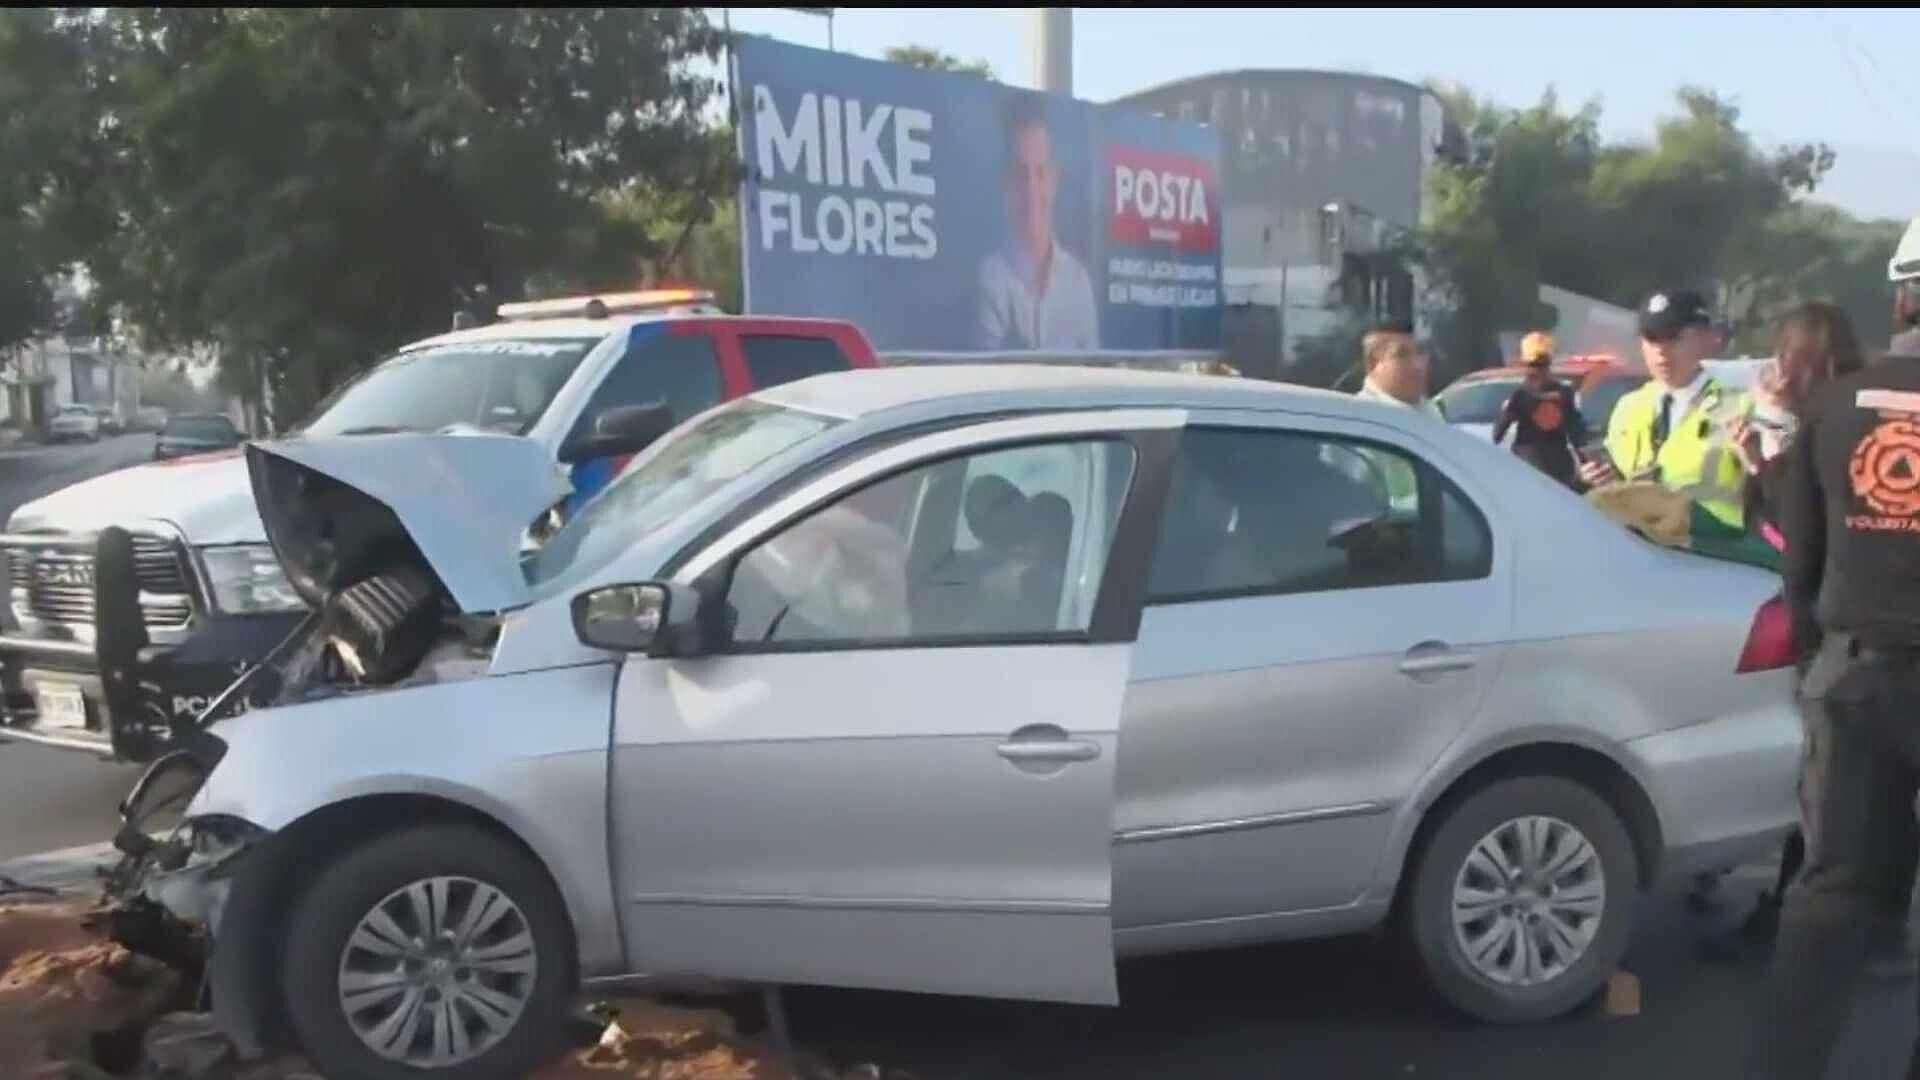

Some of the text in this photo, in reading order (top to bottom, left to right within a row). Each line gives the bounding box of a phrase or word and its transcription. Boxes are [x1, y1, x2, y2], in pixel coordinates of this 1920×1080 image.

[754, 84, 936, 195] MIKE
[760, 190, 938, 259] FLORES
[1115, 165, 1209, 225] POSTA
